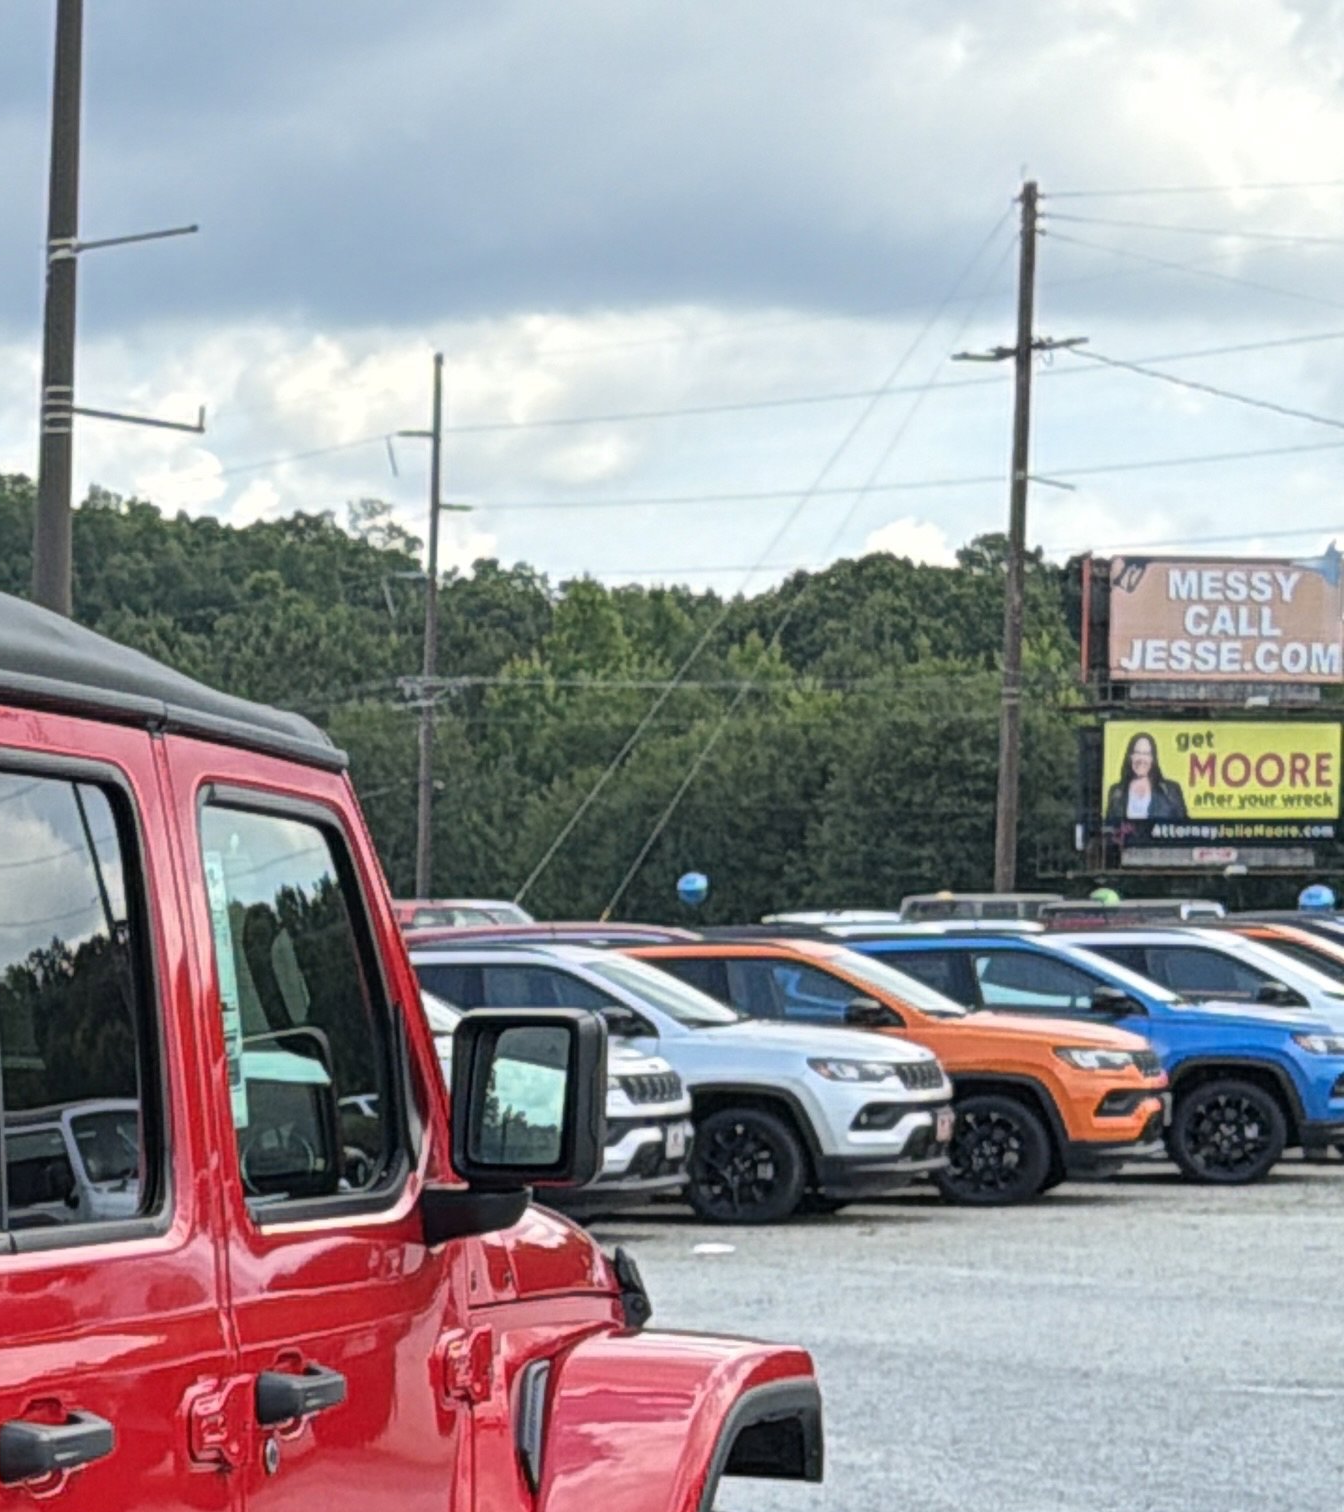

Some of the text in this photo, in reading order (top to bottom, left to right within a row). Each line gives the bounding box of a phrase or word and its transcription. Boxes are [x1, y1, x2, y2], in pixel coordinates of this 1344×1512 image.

[1168, 570, 1302, 602] MESSY
[1184, 605, 1282, 637] CALL
[1120, 640, 1341, 674] JESSE.COM
[1176, 731, 1214, 752] get
[1188, 753, 1333, 788] MOORE
[1194, 792, 1333, 809] after your wreck
